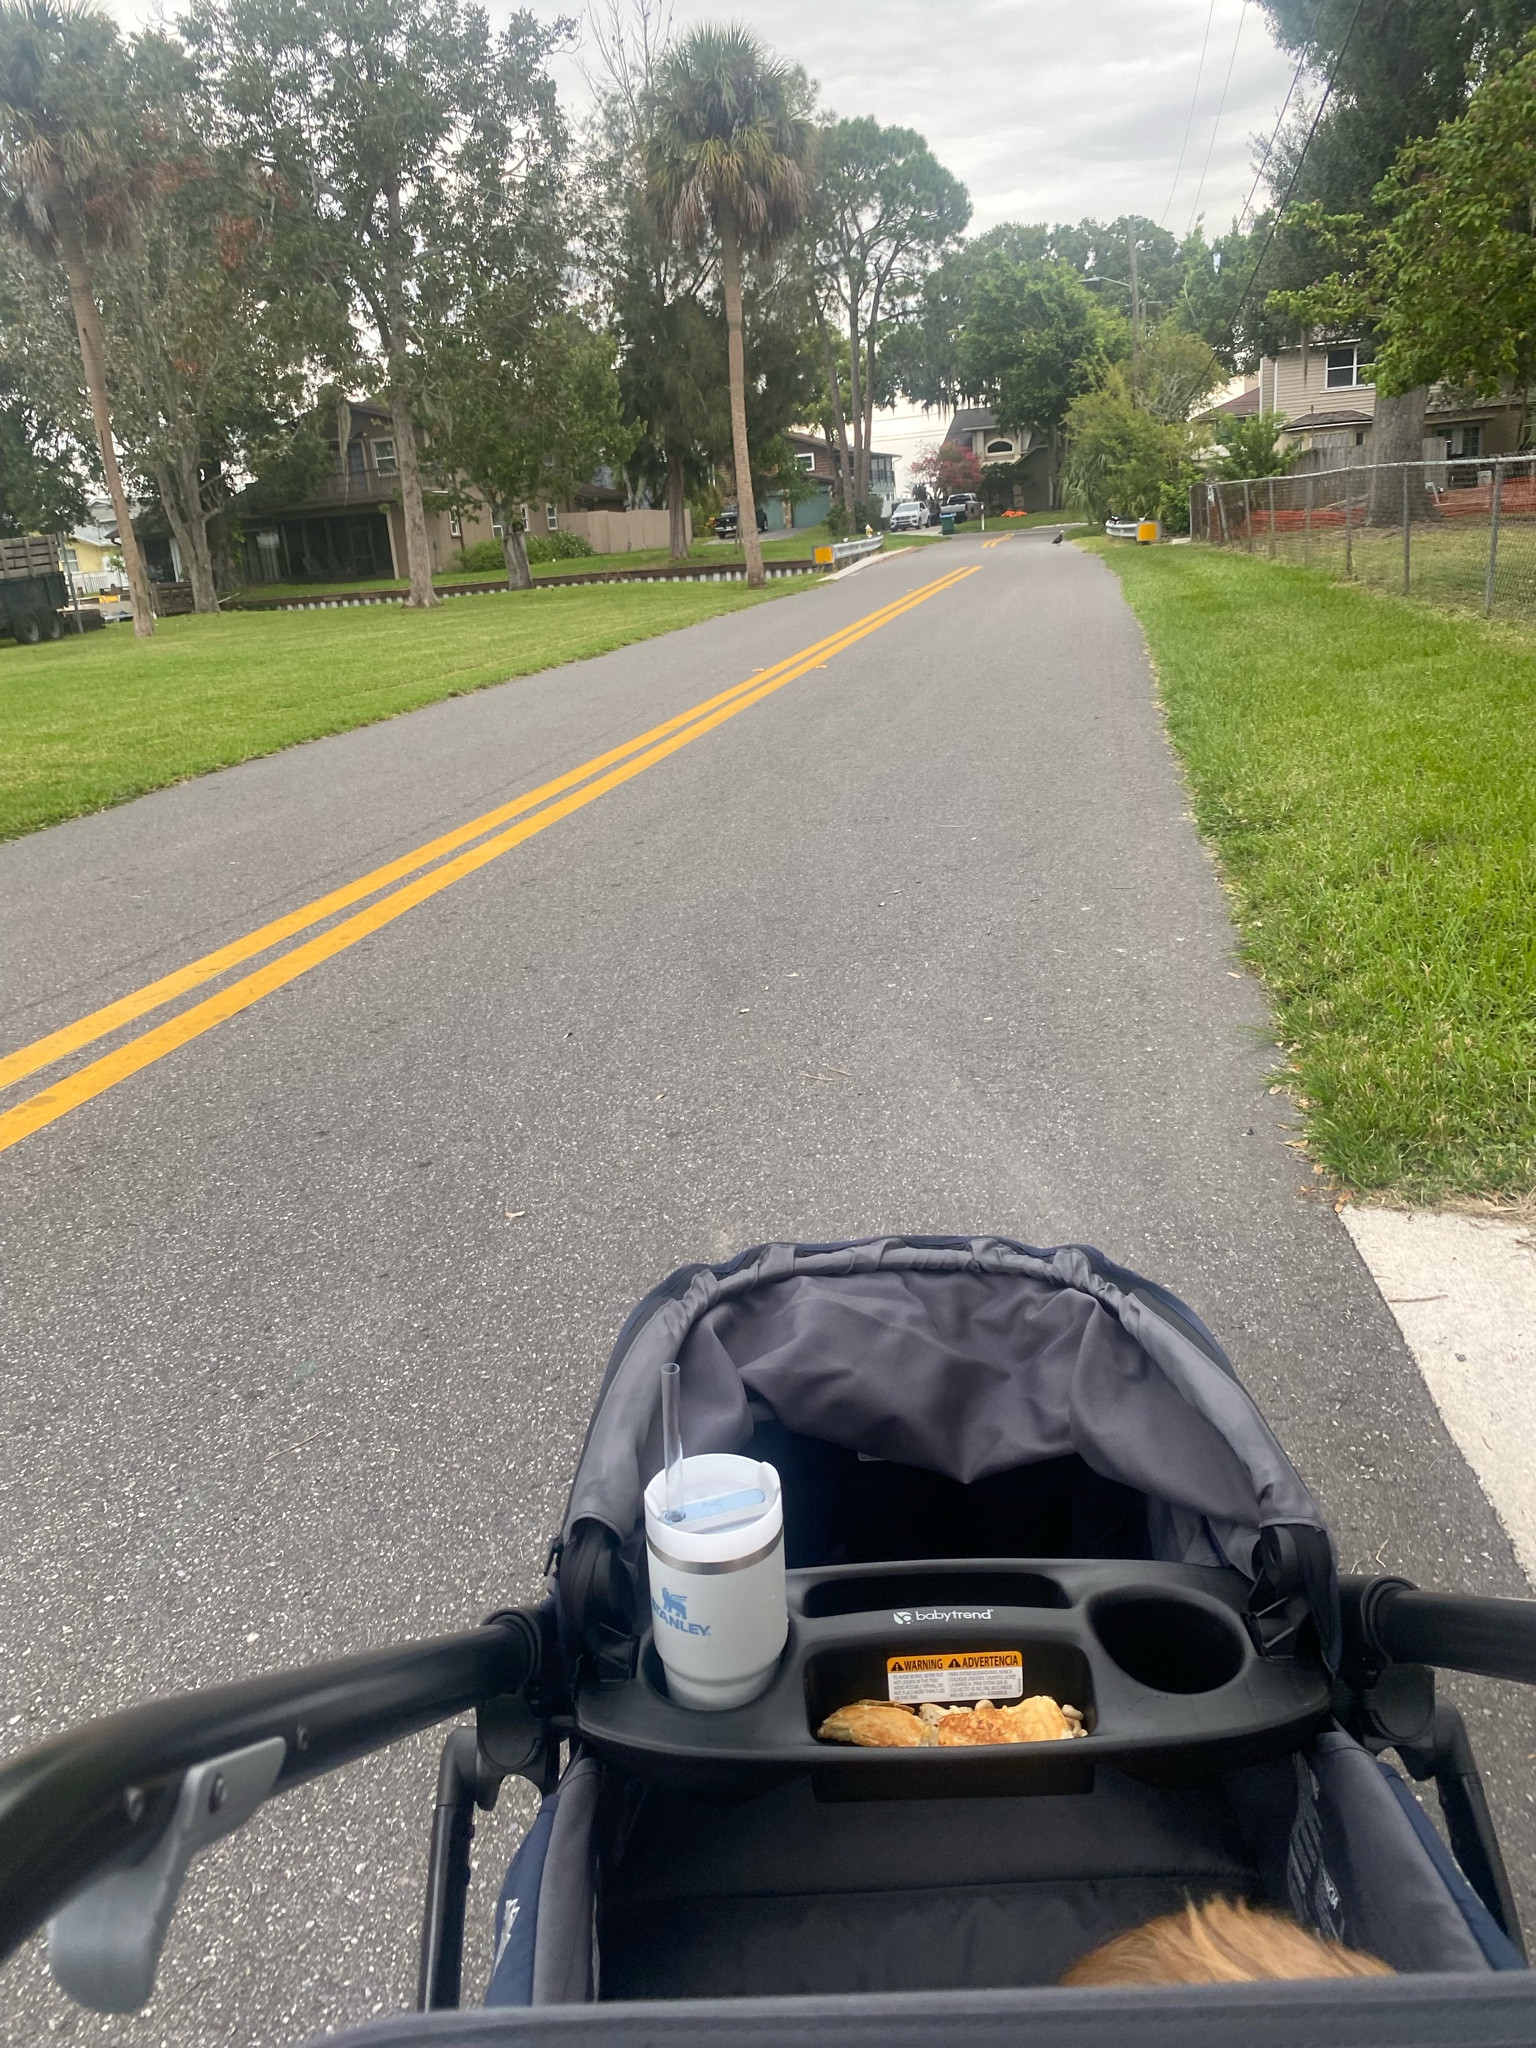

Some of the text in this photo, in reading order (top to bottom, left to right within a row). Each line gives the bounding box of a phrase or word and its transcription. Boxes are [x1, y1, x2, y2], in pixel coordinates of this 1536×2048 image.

[915, 1609, 993, 1622] babytrend
[903, 1655, 1018, 1671] WARNING ADVERTENCIA
